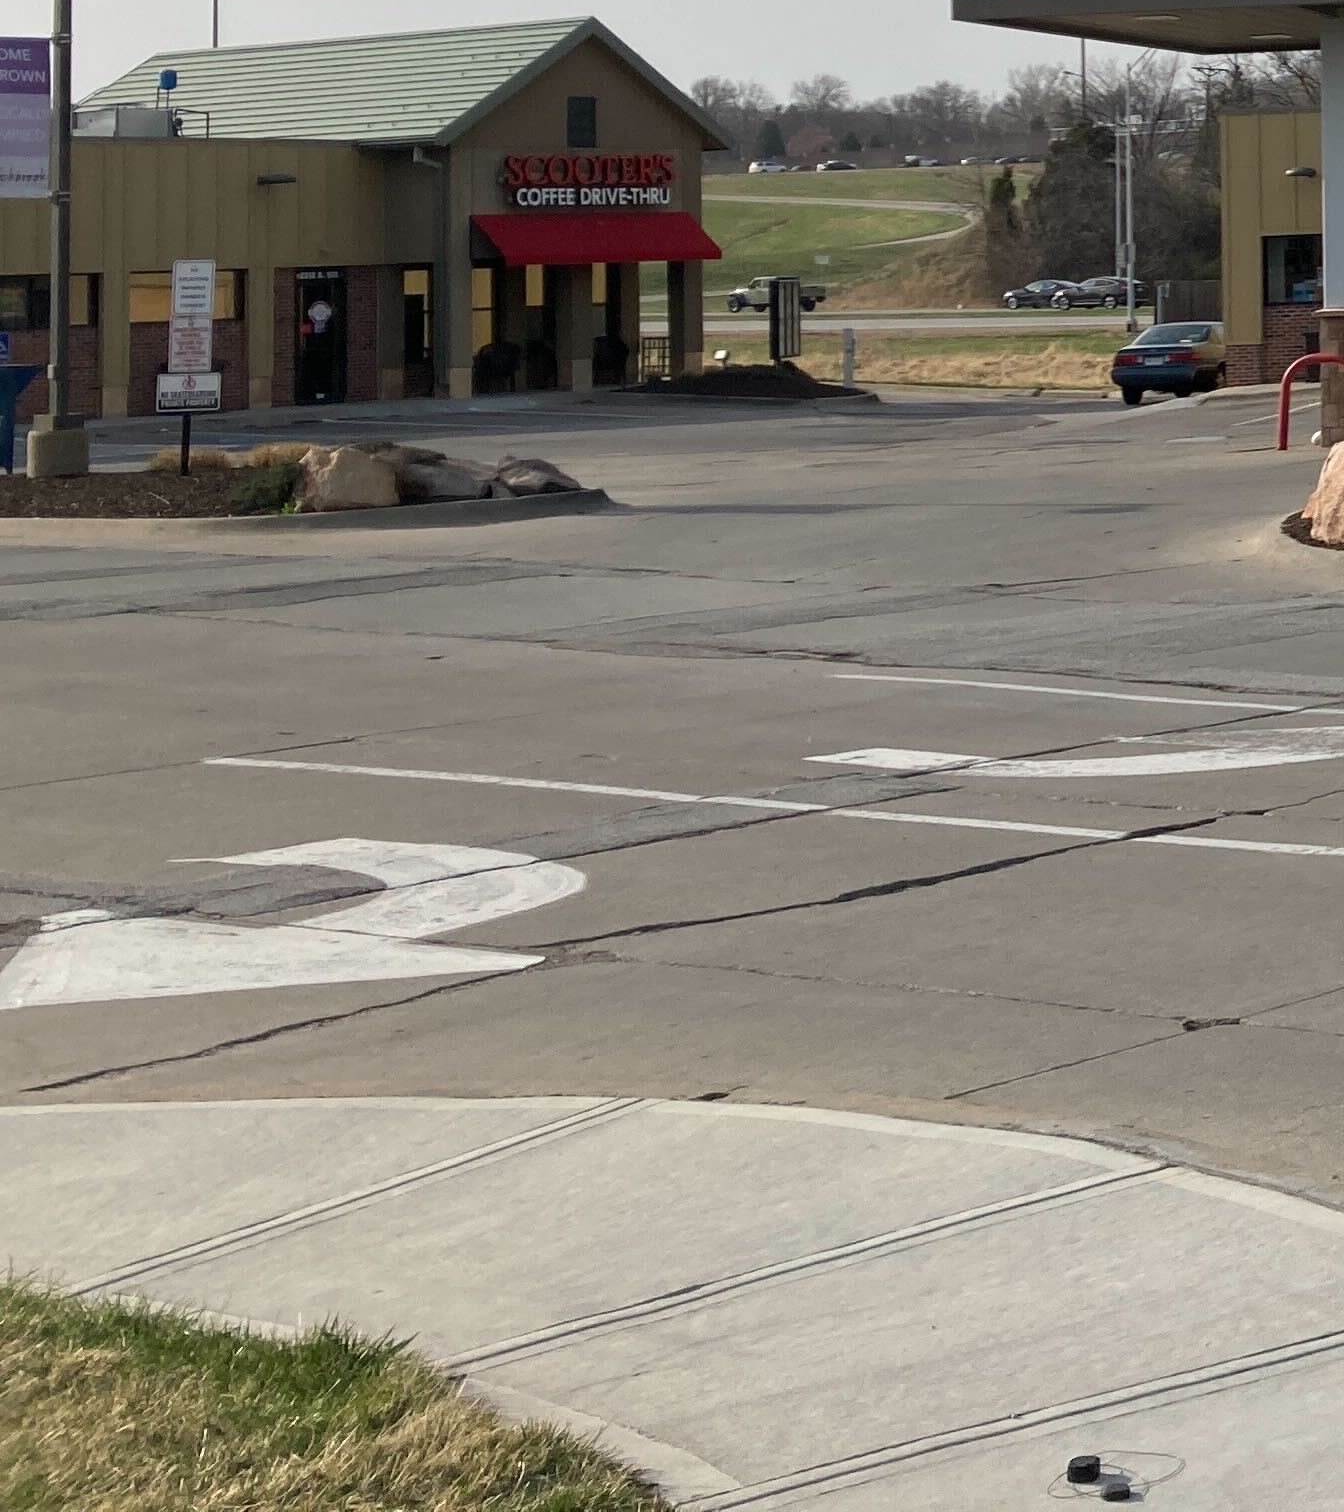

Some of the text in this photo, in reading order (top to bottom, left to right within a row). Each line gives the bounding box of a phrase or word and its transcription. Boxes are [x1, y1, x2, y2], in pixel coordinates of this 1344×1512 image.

[0, 48, 32, 61] OME
[0, 69, 46, 82] ROWN
[507, 154, 675, 185] SCOOTER'S
[517, 187, 670, 206] COFFEE DRIVE-THRU
